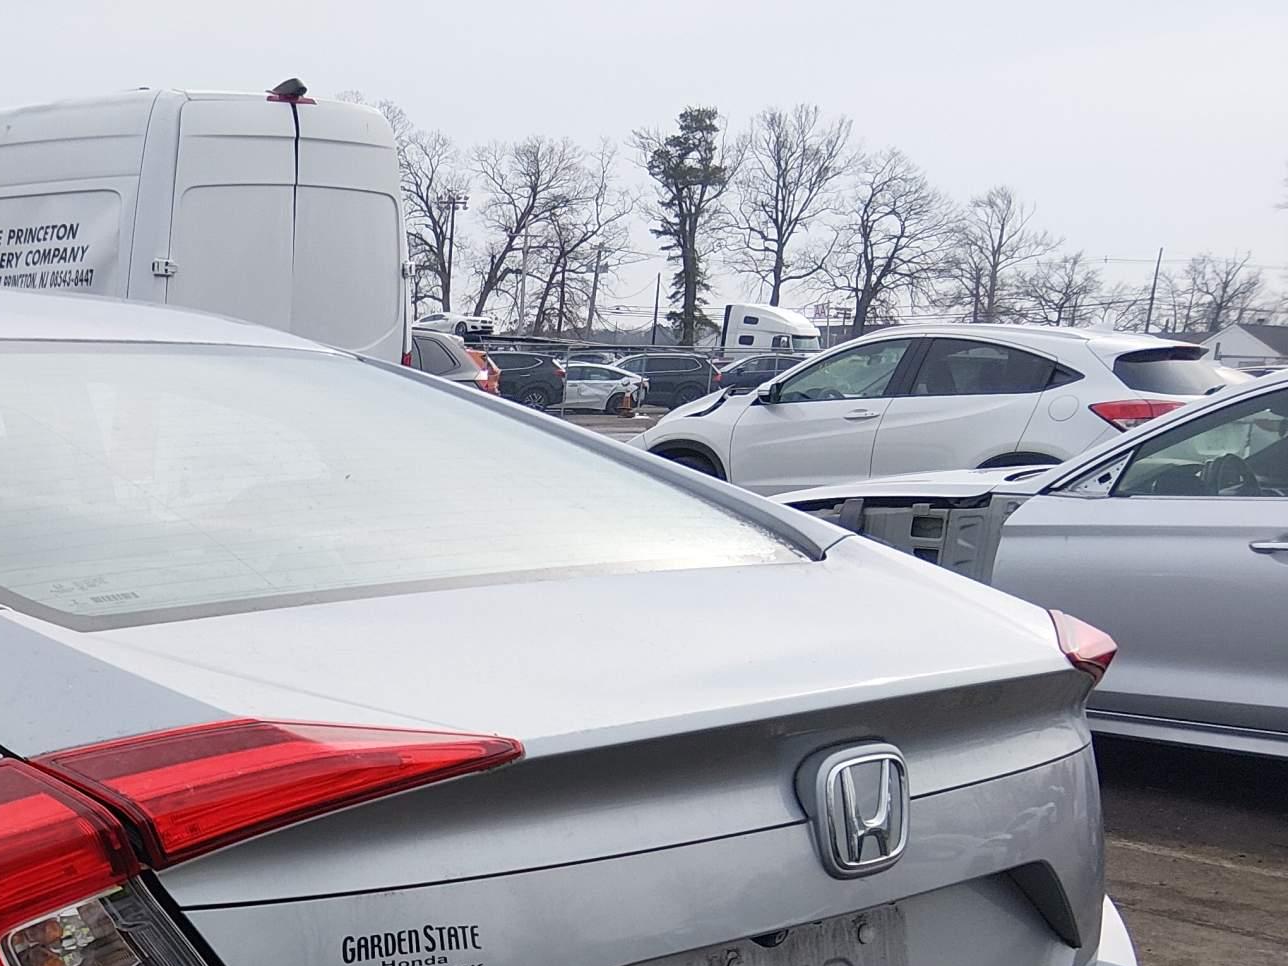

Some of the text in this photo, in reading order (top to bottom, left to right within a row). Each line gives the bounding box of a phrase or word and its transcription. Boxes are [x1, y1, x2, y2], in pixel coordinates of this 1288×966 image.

[7, 223, 80, 246] PRINCETON
[25, 245, 90, 267] COMPANY
[38, 271, 50, 289] NJ
[50, 268, 94, 288] 08543-8447
[342, 924, 482, 964] GARDEN STATE
